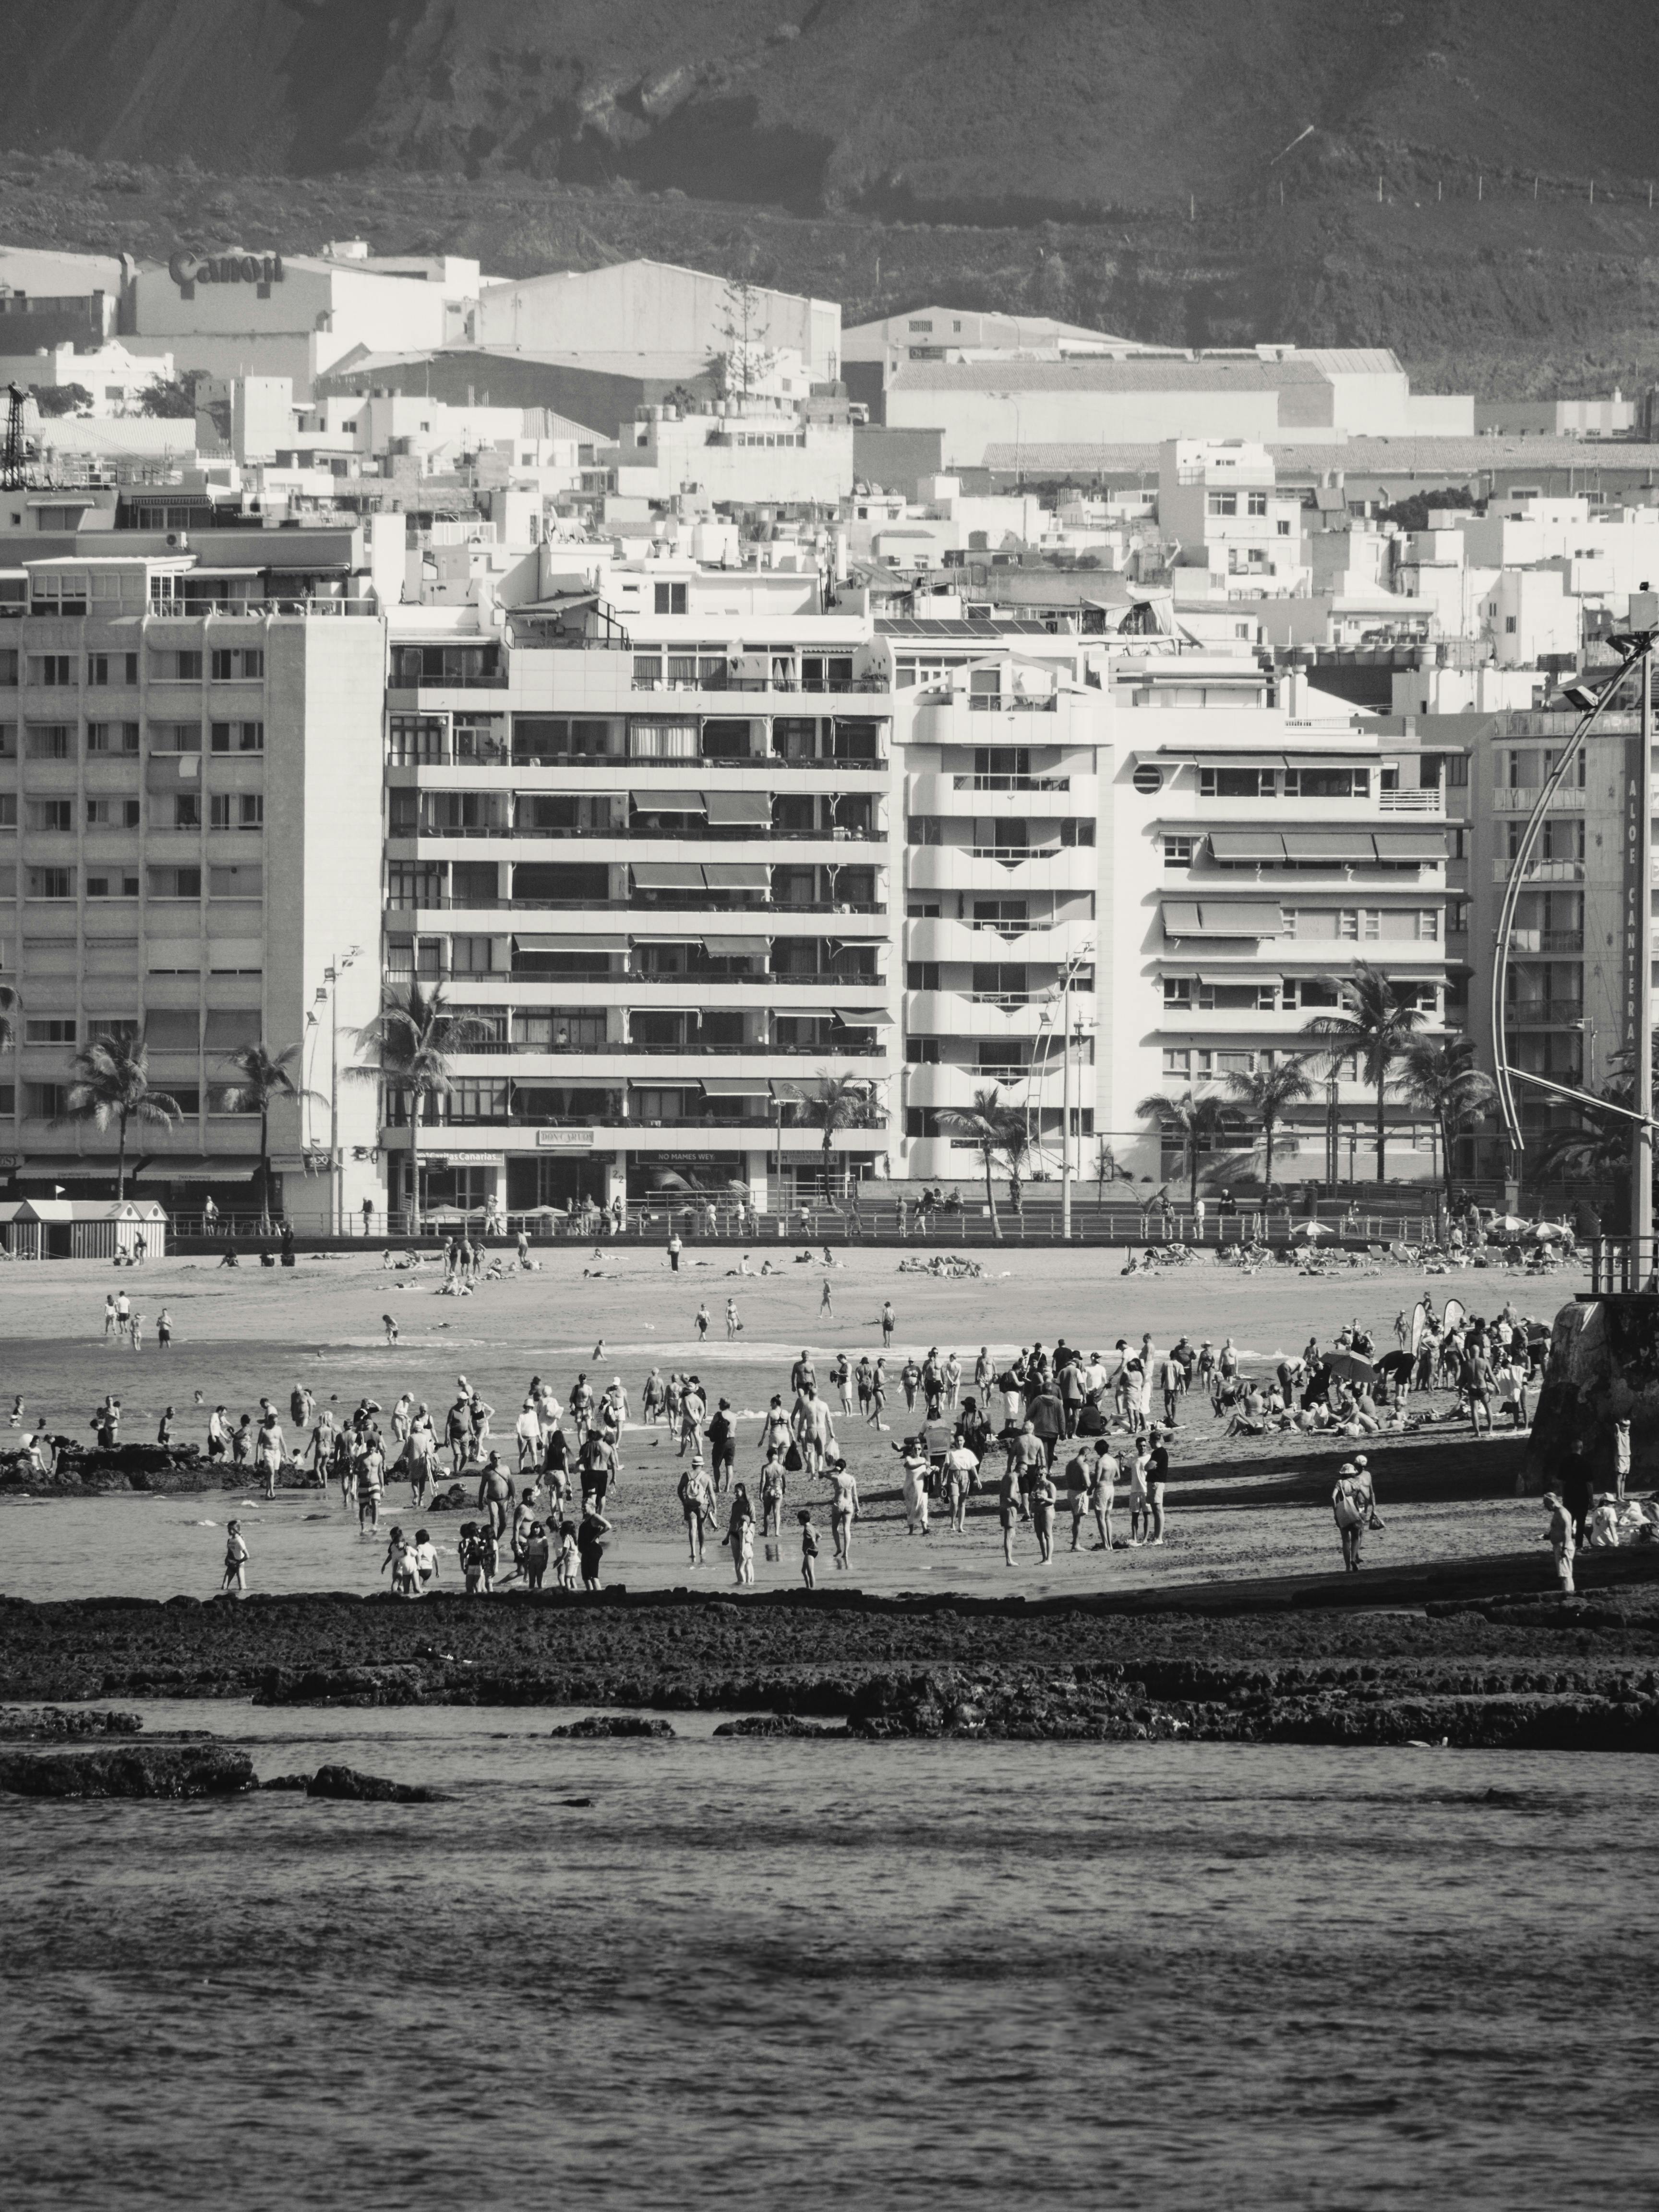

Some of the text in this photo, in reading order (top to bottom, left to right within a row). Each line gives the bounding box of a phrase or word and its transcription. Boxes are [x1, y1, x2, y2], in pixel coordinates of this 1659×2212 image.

[168, 251, 284, 286] Canon
[541, 1133, 558, 1142] DON
[105, 1203, 122, 1217] 2
